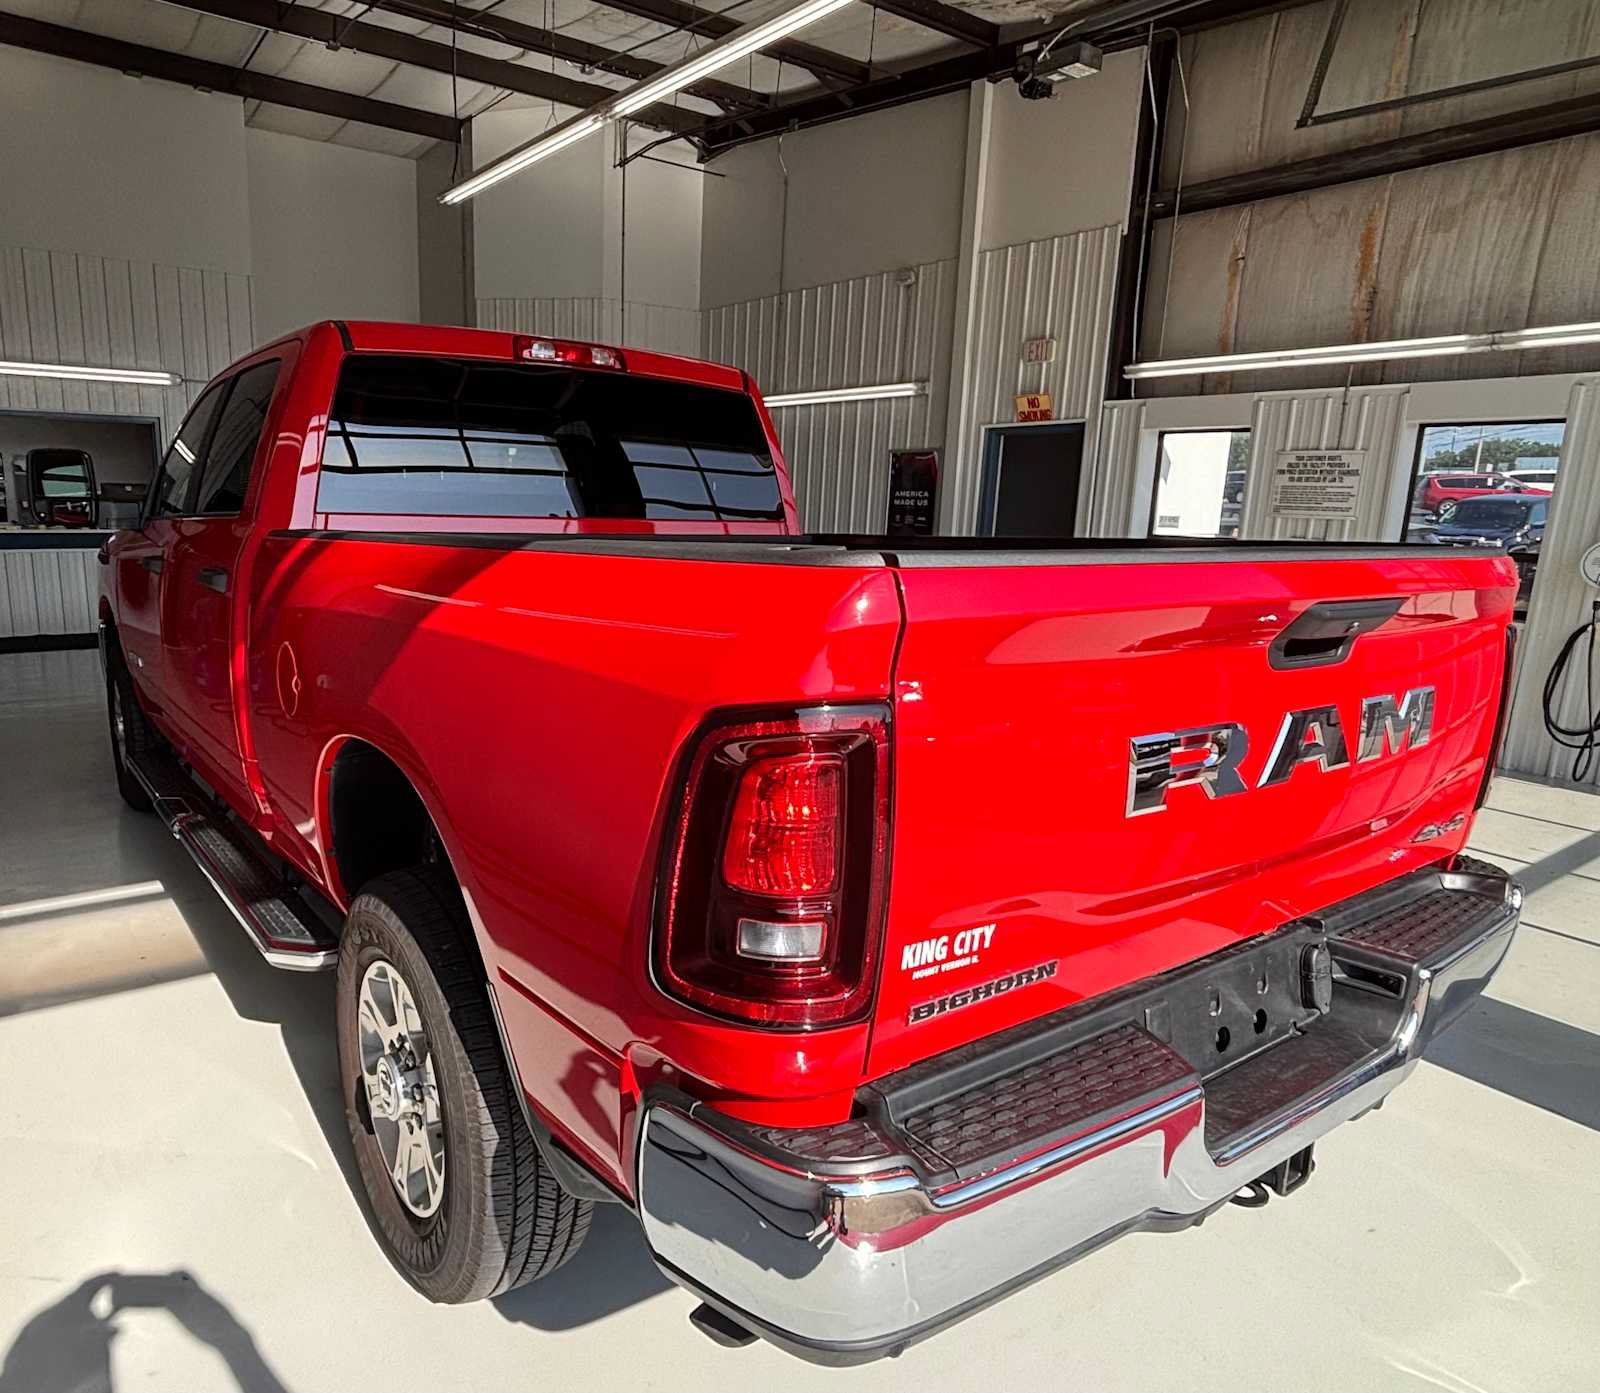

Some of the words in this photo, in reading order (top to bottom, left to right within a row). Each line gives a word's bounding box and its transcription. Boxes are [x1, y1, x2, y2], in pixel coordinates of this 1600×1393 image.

[1028, 340, 1049, 361] EXIT
[1019, 409, 1053, 420] SMOKING
[1027, 397, 1040, 409] NO
[1125, 686, 1436, 819] RAM
[901, 935, 949, 971] KING
[953, 923, 997, 957] CITY
[912, 965, 940, 980] MOUNT
[941, 956, 970, 973] VERNON
[907, 959, 1059, 1025] BIGHORN
